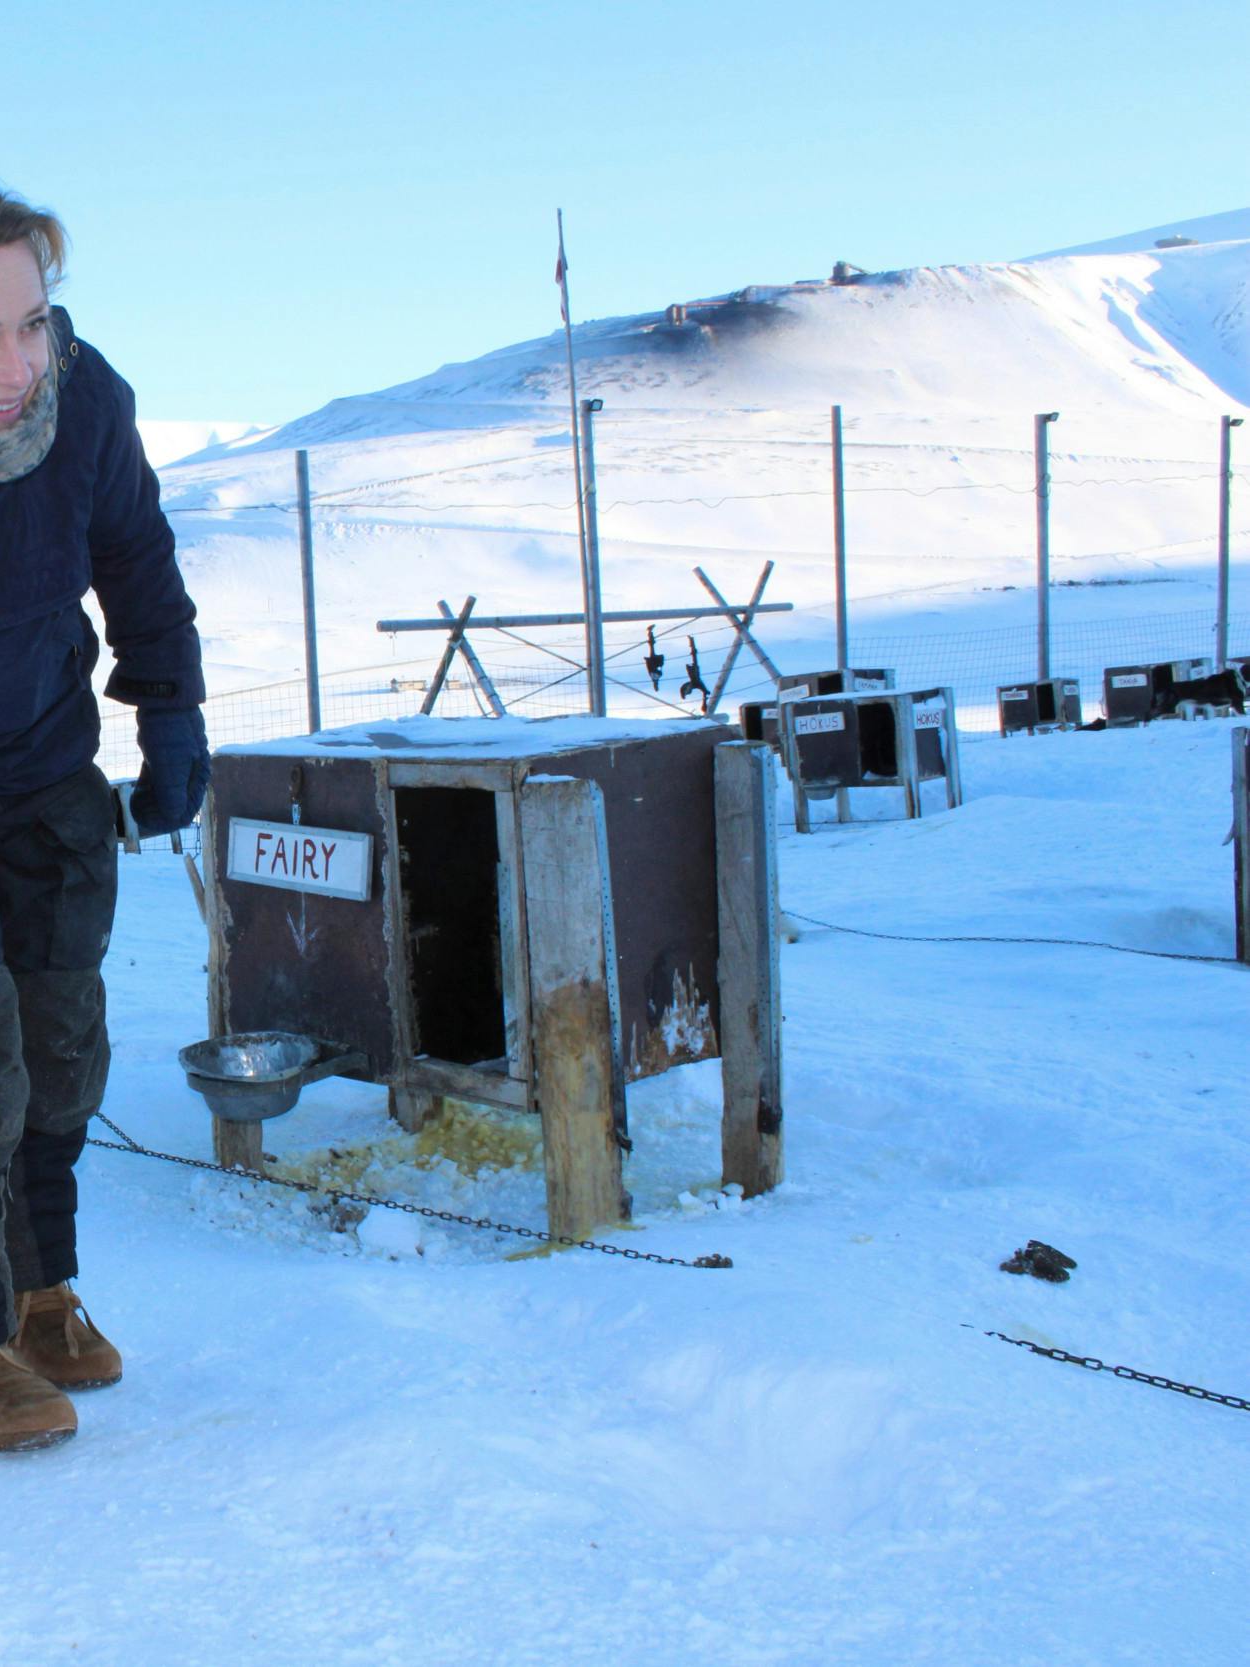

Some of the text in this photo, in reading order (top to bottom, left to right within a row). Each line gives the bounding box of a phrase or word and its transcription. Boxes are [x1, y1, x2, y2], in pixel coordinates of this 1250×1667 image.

[799, 715, 839, 731] HOKUS
[916, 711, 940, 725] HOKUS
[255, 832, 337, 882] FAIRY
